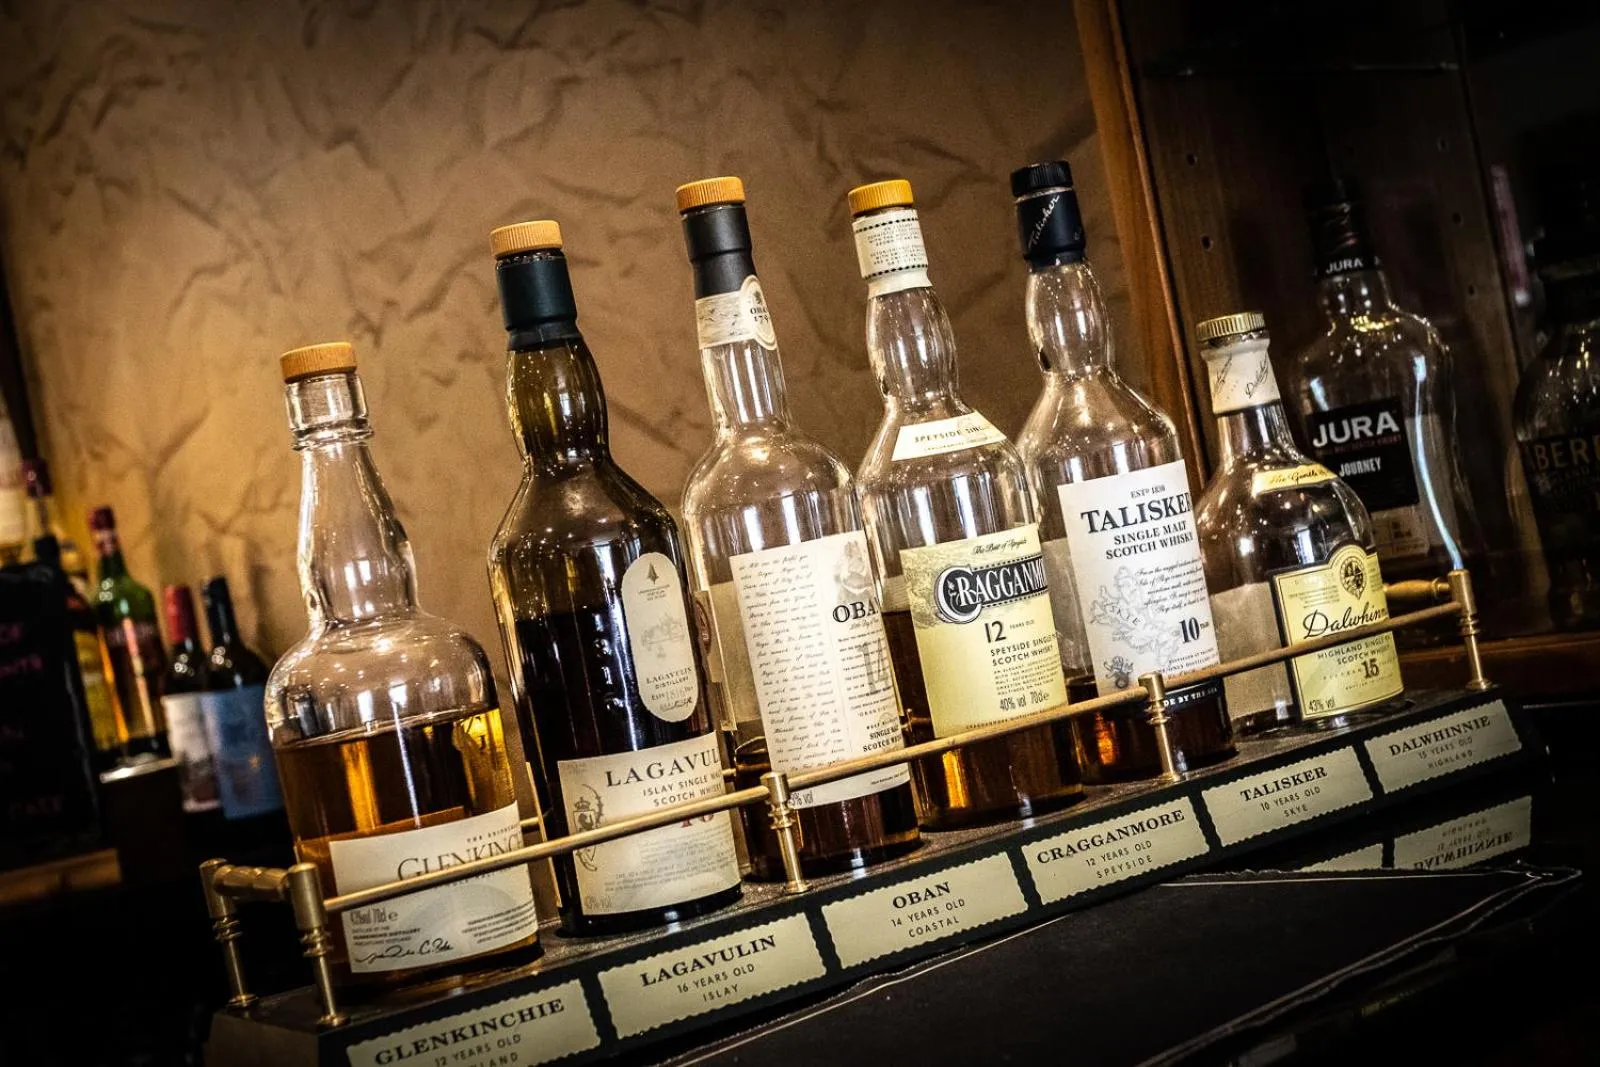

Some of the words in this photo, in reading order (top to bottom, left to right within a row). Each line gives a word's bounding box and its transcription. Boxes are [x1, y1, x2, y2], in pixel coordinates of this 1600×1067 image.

[1325, 257, 1364, 274] JURA
[1312, 410, 1400, 448] JURA
[1339, 456, 1381, 477] JOURNEY
[1113, 527, 1161, 545] SINGLE
[1163, 520, 1187, 535] MALT
[1105, 541, 1157, 560] SCOTCH
[833, 597, 879, 623] OBA
[984, 620, 1007, 643] 12
[1179, 616, 1200, 645] 10
[990, 641, 1030, 657] SPEYSIDE
[992, 652, 1030, 667] SCOTCH
[1318, 643, 1362, 661] HIGHLAND
[1336, 651, 1369, 666] SCOTCH
[1361, 658, 1380, 679] 15
[1389, 715, 1491, 757] DALWHINNIE
[1430, 743, 1455, 755] YEARS
[1458, 735, 1473, 747] OLD
[1427, 750, 1473, 770] HIGHLAND
[643, 783, 675, 798] ISLAY
[678, 775, 708, 789] SINGLE
[1240, 766, 1328, 802] TALISKER
[653, 791, 696, 808] SCOTCH
[1260, 802, 1270, 812] 10
[1274, 792, 1300, 807] YEARS
[1304, 785, 1321, 797] OLD
[1283, 803, 1309, 818] SKYE
[1036, 809, 1185, 864] CRAGGANMORE
[397, 833, 523, 881] GLENKINC
[1085, 858, 1096, 868] 12
[1100, 847, 1130, 863] YEARS
[1134, 840, 1152, 853] OLD
[1096, 855, 1153, 880] SPEYSIDE
[892, 881, 951, 909] OBAN
[891, 917, 902, 928] 14
[907, 906, 940, 923] YEARS
[945, 898, 965, 911] OLD
[908, 915, 960, 938] COASTAL
[640, 934, 776, 987] LAGAVULIN
[677, 983, 689, 994] 16
[693, 971, 729, 989] YEARS
[732, 962, 755, 977] OLD
[702, 984, 739, 1003] ISLAY
[374, 998, 565, 1066] GLENKINCHIE
[451, 1043, 492, 1062] YEARS
[497, 1034, 521, 1049] OLD
